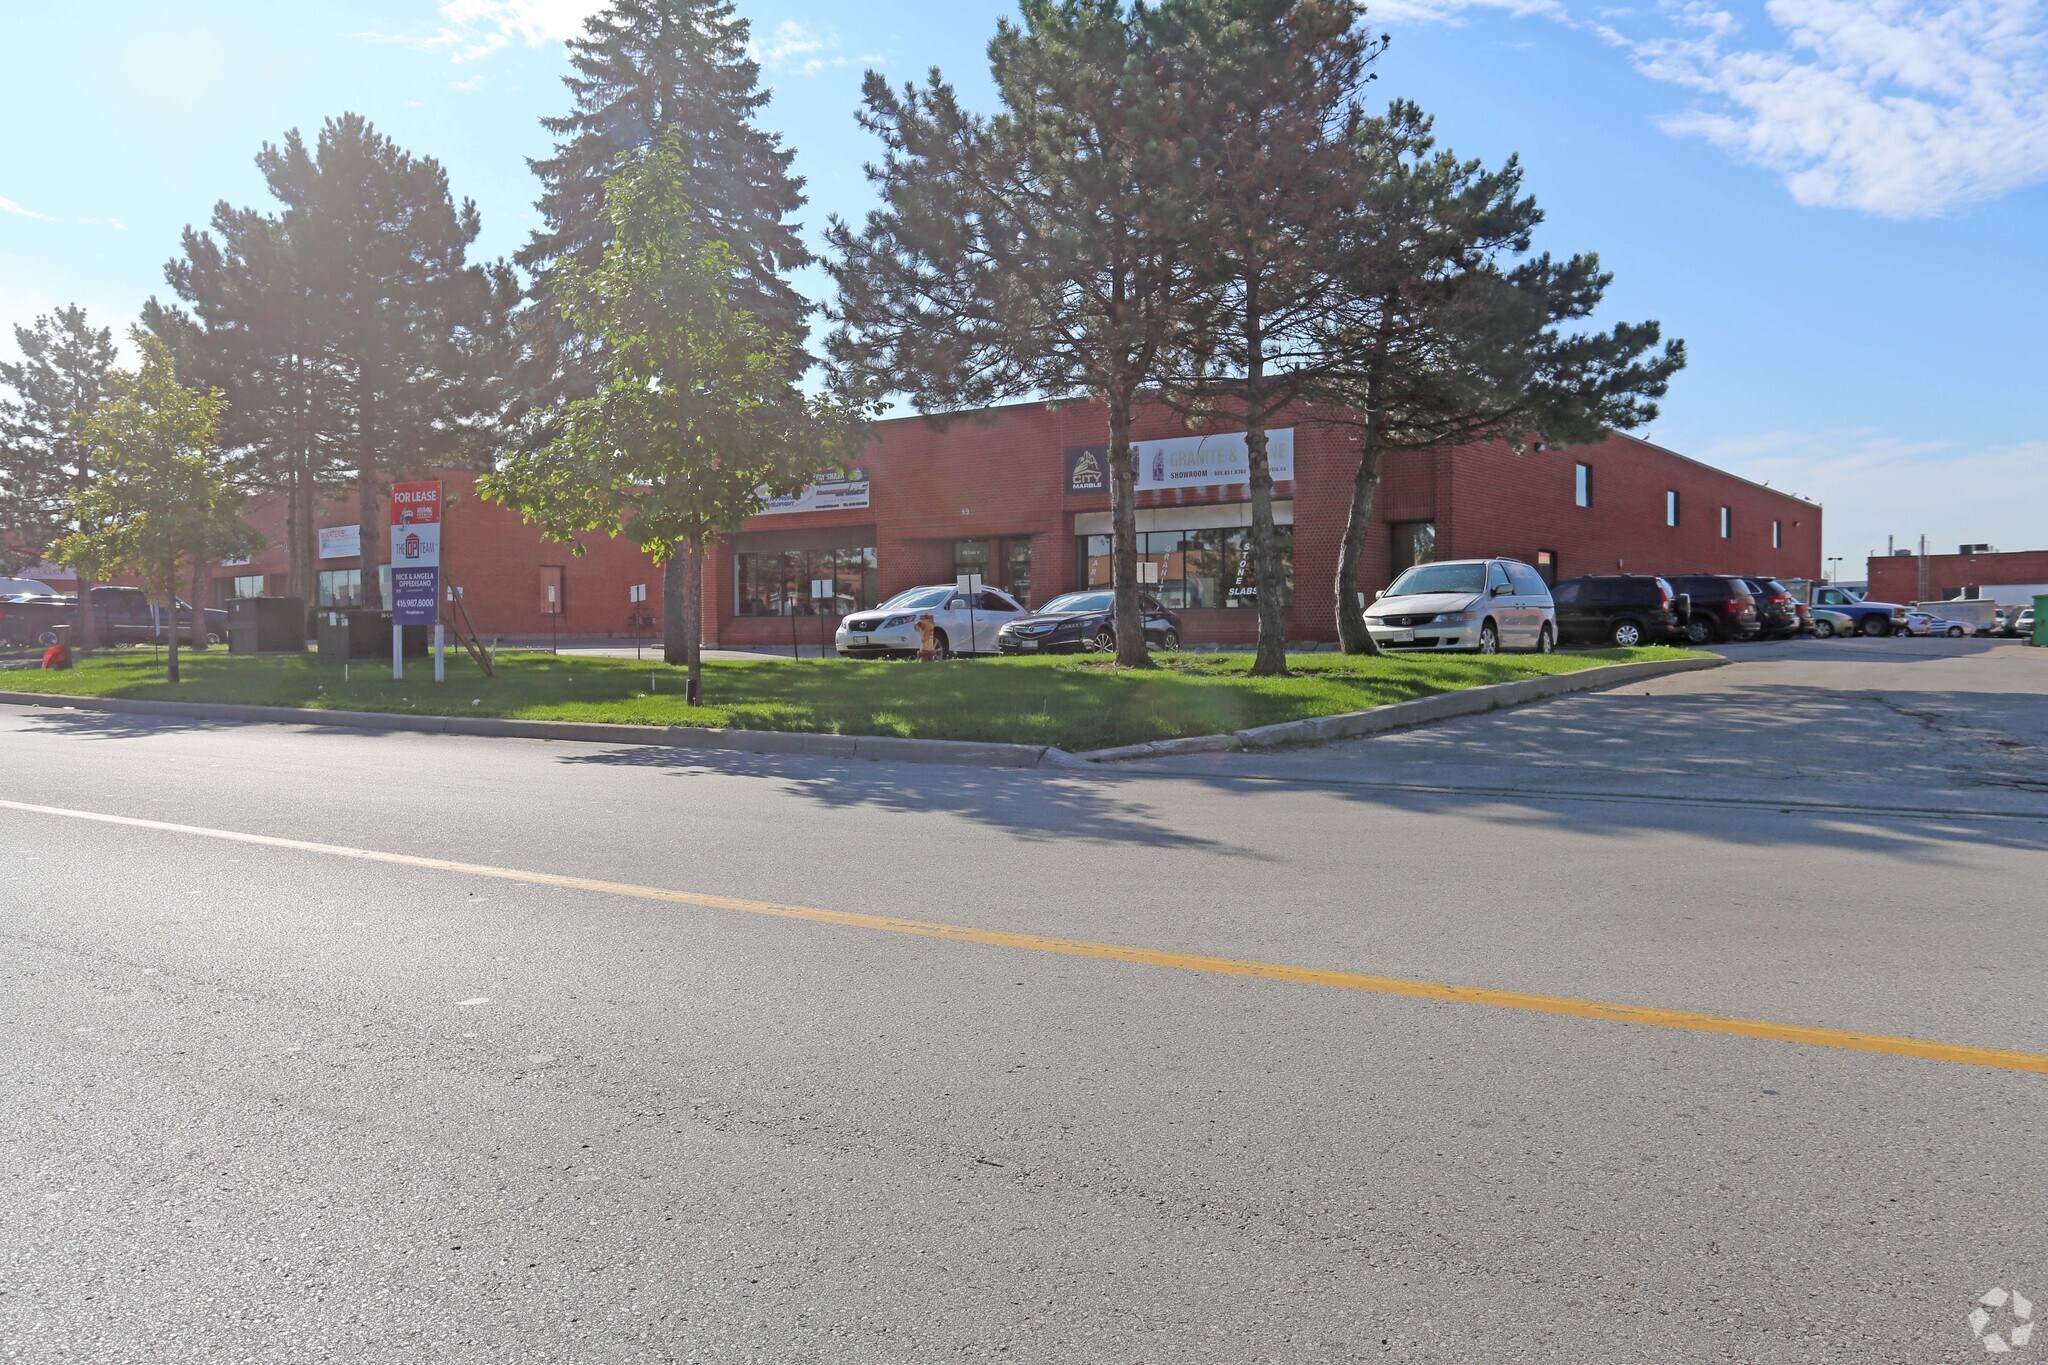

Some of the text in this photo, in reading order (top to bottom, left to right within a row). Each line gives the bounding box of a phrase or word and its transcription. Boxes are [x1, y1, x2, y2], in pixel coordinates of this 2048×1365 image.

[1170, 448, 1224, 467] GRANITE
[1229, 447, 1238, 462] &
[1073, 472, 1102, 484] CITY
[1170, 470, 1208, 479] SHOWROOM
[394, 490, 437, 503] FOR LEASE
[961, 508, 970, 516] 89
[396, 543, 405, 555] THE
[420, 542, 434, 554] TEAM
[1235, 542, 1250, 585] STONE
[395, 573, 408, 581] NICK
[413, 572, 434, 580] ANGELA
[1156, 545, 1171, 600] GRANITE
[399, 579, 431, 587] OPPEDISANO
[1228, 587, 1258, 596] SLABS
[396, 599, 434, 607] 416.987.8000
